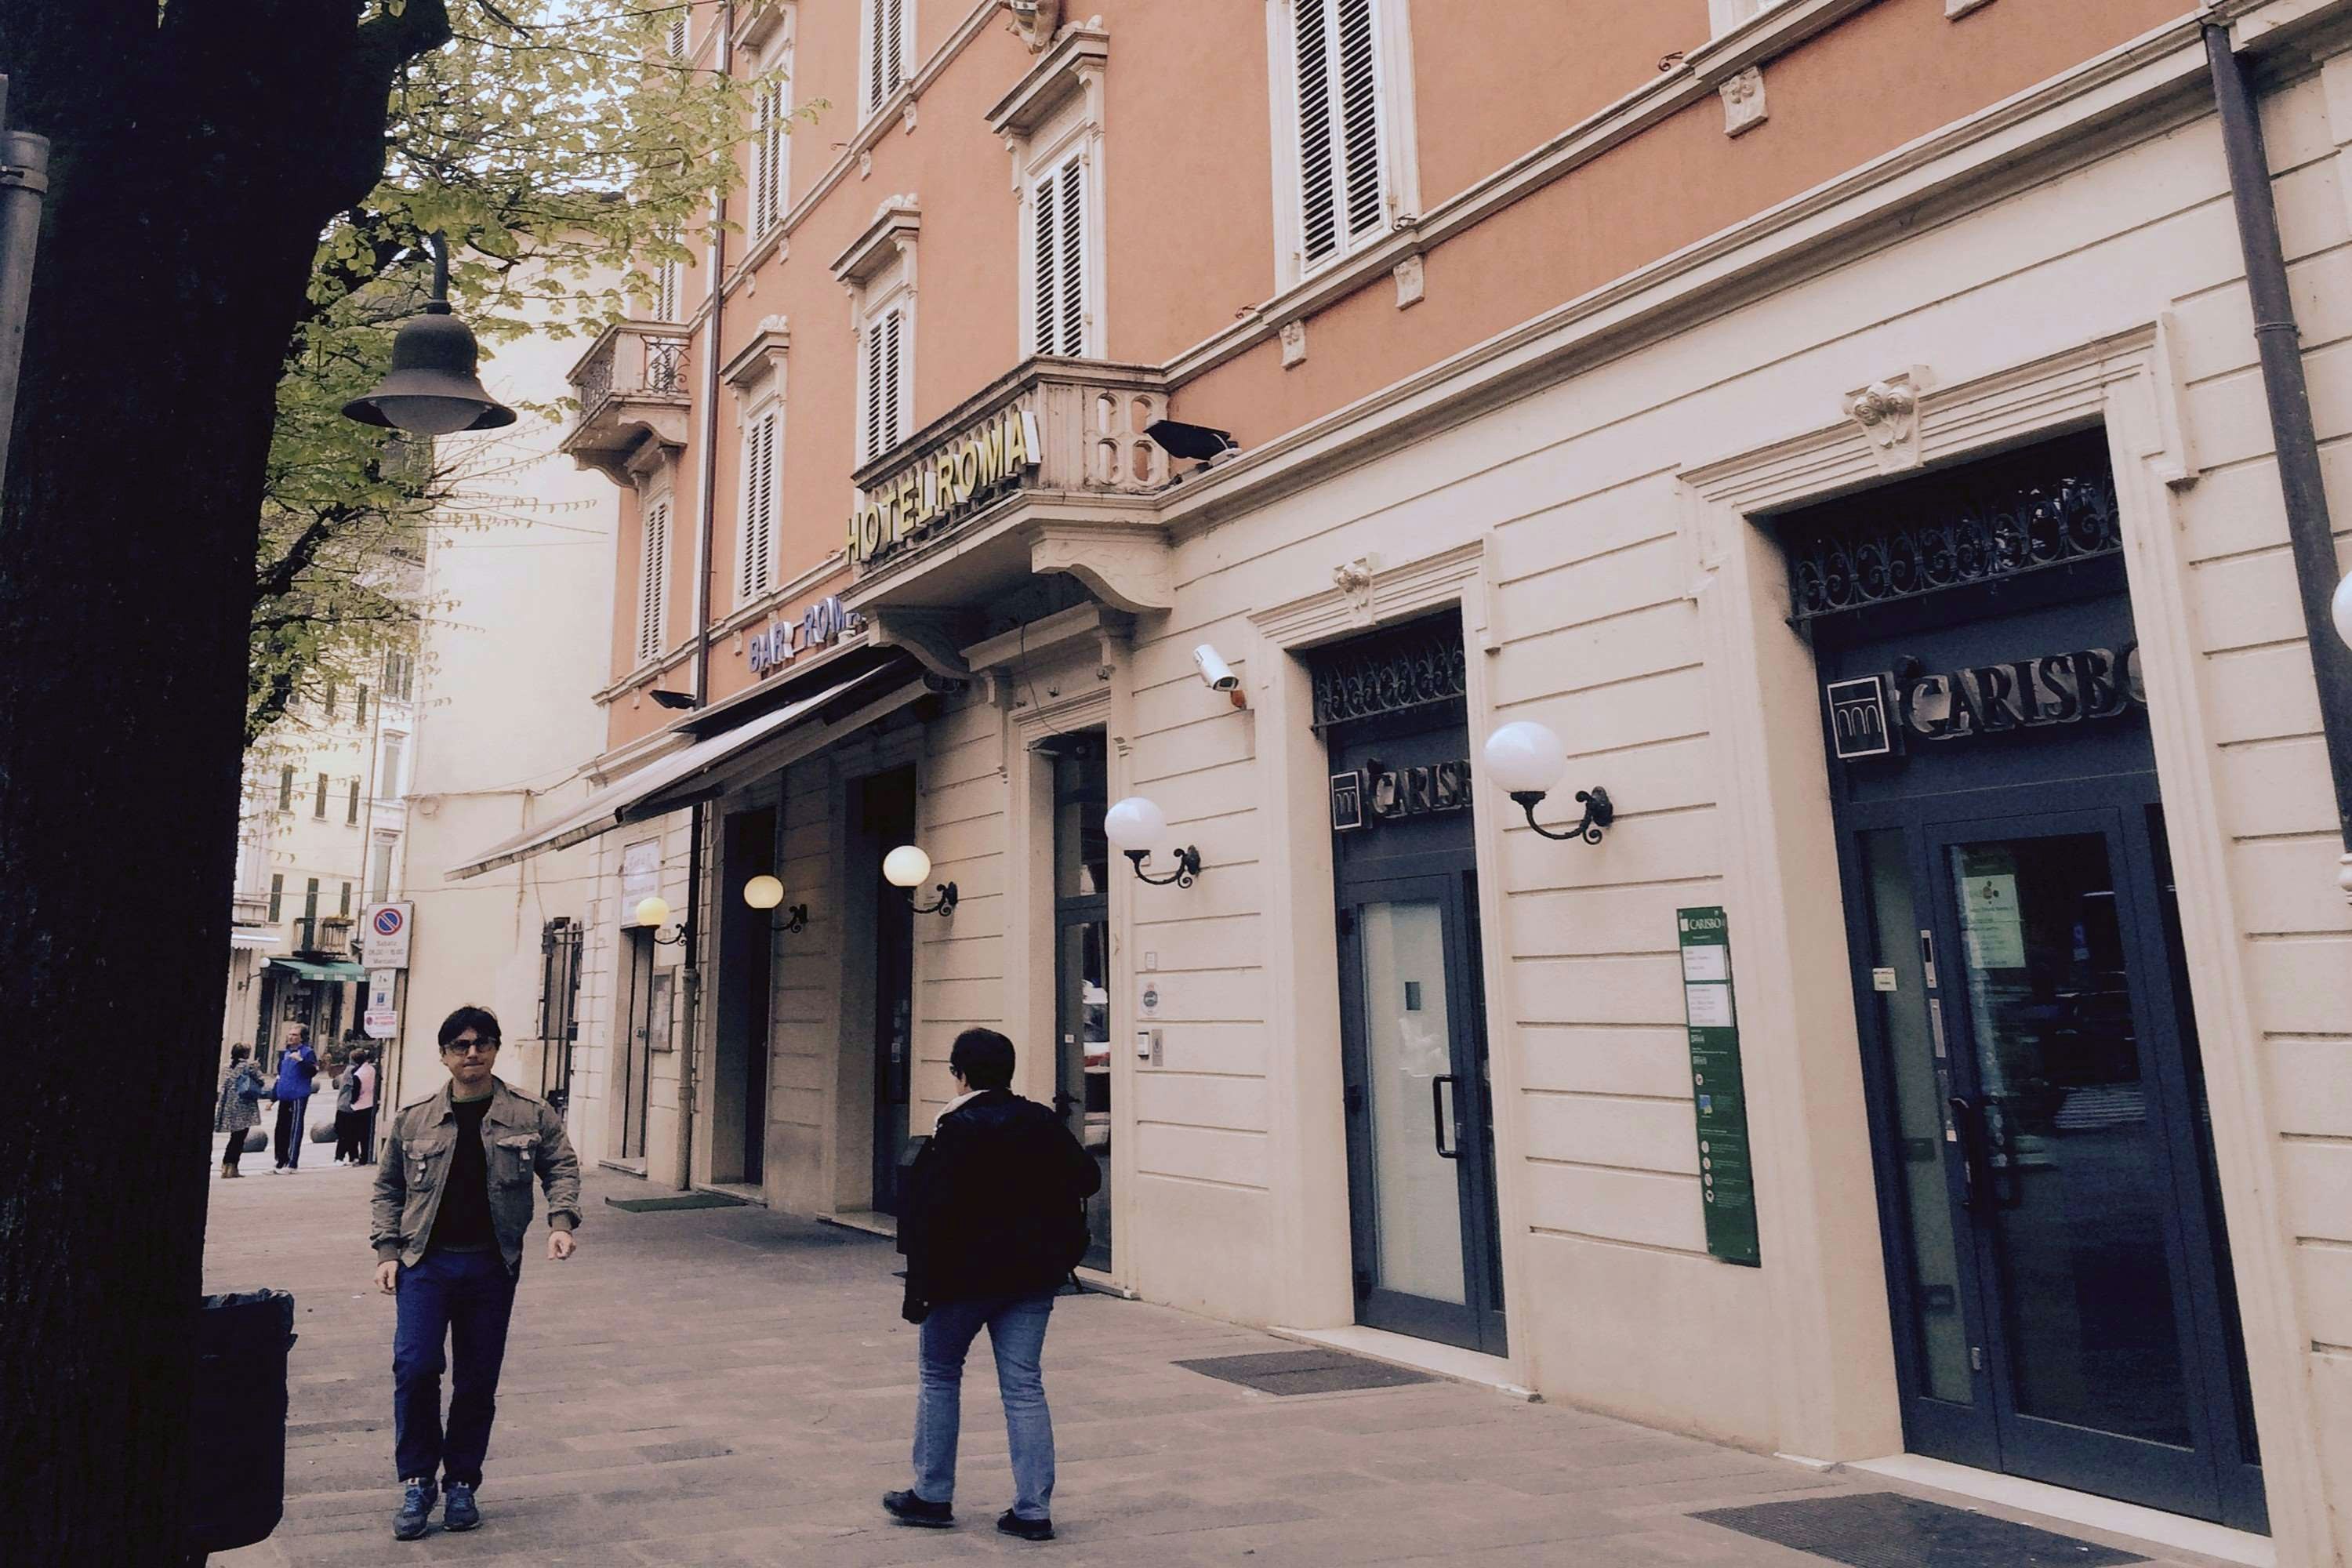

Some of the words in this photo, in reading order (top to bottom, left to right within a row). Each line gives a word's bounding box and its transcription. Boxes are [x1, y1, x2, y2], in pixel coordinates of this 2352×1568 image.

[845, 470, 936, 565] HOTEL
[937, 411, 1035, 506] ROMA
[749, 622, 792, 673] BAR
